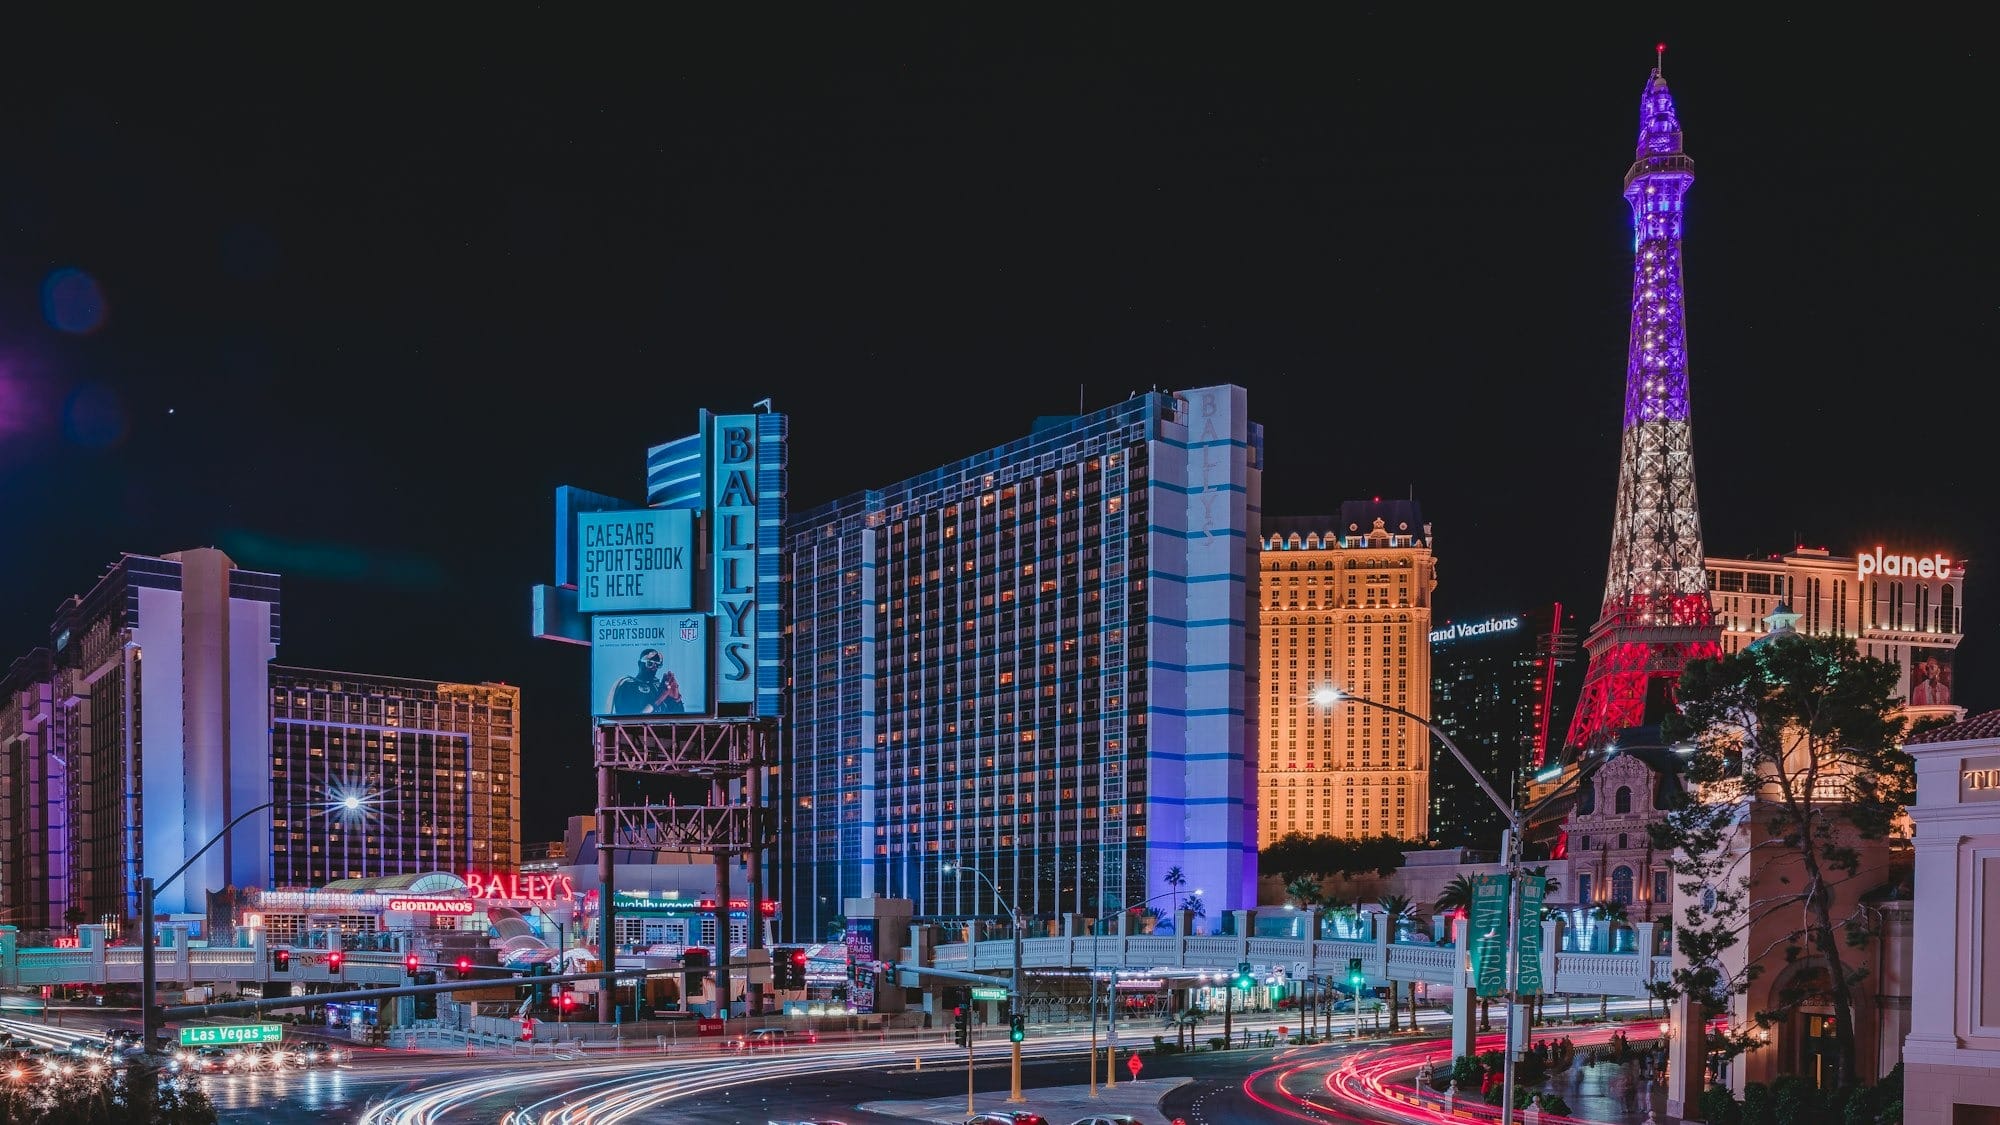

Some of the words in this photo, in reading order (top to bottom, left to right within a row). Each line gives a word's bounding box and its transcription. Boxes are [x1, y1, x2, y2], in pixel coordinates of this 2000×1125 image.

[586, 522, 654, 548] CAESARS
[586, 546, 684, 573] SPORTSBOOK
[1858, 546, 1951, 582] planet
[585, 575, 600, 598] IS
[606, 573, 644, 597] HERE
[599, 627, 665, 640] SPORTSBOOK
[600, 618, 638, 627] CAESARS
[681, 628, 697, 640] NFL
[1429, 625, 1455, 642] rand
[1456, 617, 1518, 637] Vacations
[1963, 769, 2000, 790] TI
[467, 873, 572, 901] BALLY'S
[391, 901, 473, 912] GIORDANO'S
[1475, 899, 1503, 928] LAS
[1523, 900, 1539, 928] LAS
[1521, 934, 1539, 985] VEGAS
[191, 1029, 216, 1042] Las
[219, 1026, 259, 1043] Vegas
[262, 1025, 280, 1033] BLVD
